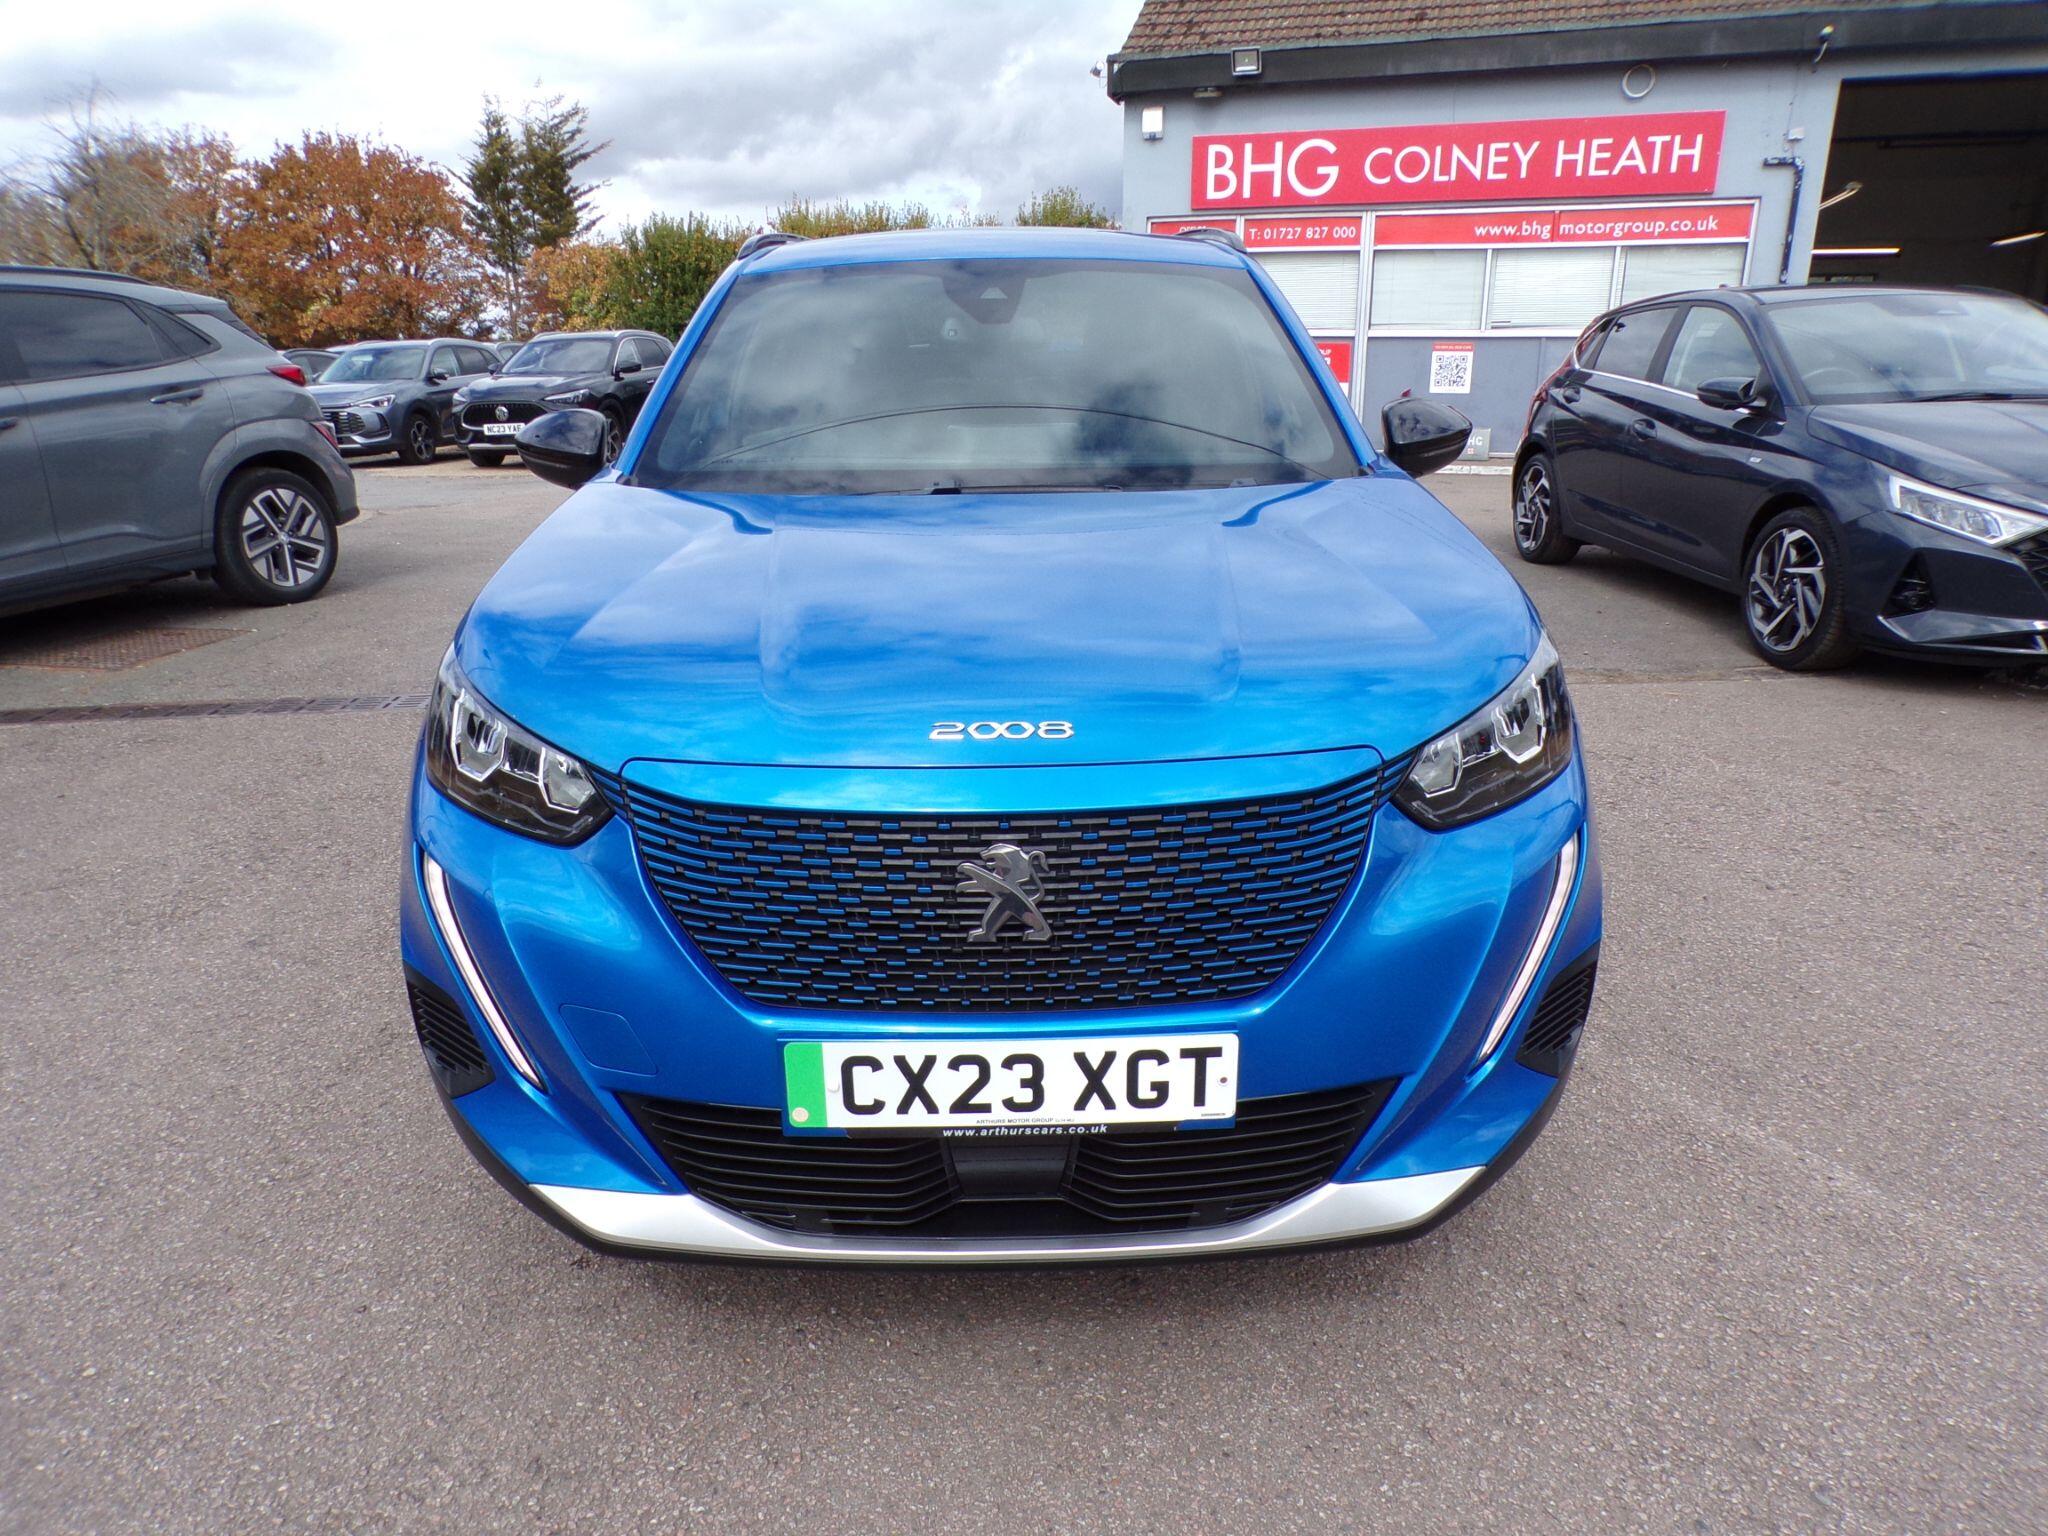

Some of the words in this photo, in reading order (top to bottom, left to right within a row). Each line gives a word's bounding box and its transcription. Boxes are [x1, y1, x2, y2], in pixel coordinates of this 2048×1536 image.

[1206, 138, 1340, 200] BHG
[1363, 140, 1541, 185] COLNEY
[1554, 133, 1704, 178] HEATH
[1249, 228, 1260, 241] T:
[1263, 227, 1301, 240] 01727
[1305, 226, 1328, 239] 827
[1333, 226, 1356, 239] 000
[486, 425, 506, 434] NC23
[1467, 436, 1483, 446] HG
[929, 720, 1075, 740] 2008
[840, 1053, 1045, 1116] CX23
[1073, 1046, 1223, 1111] XGT
[942, 1123, 1108, 1137] www.arthurscars.co.uk
